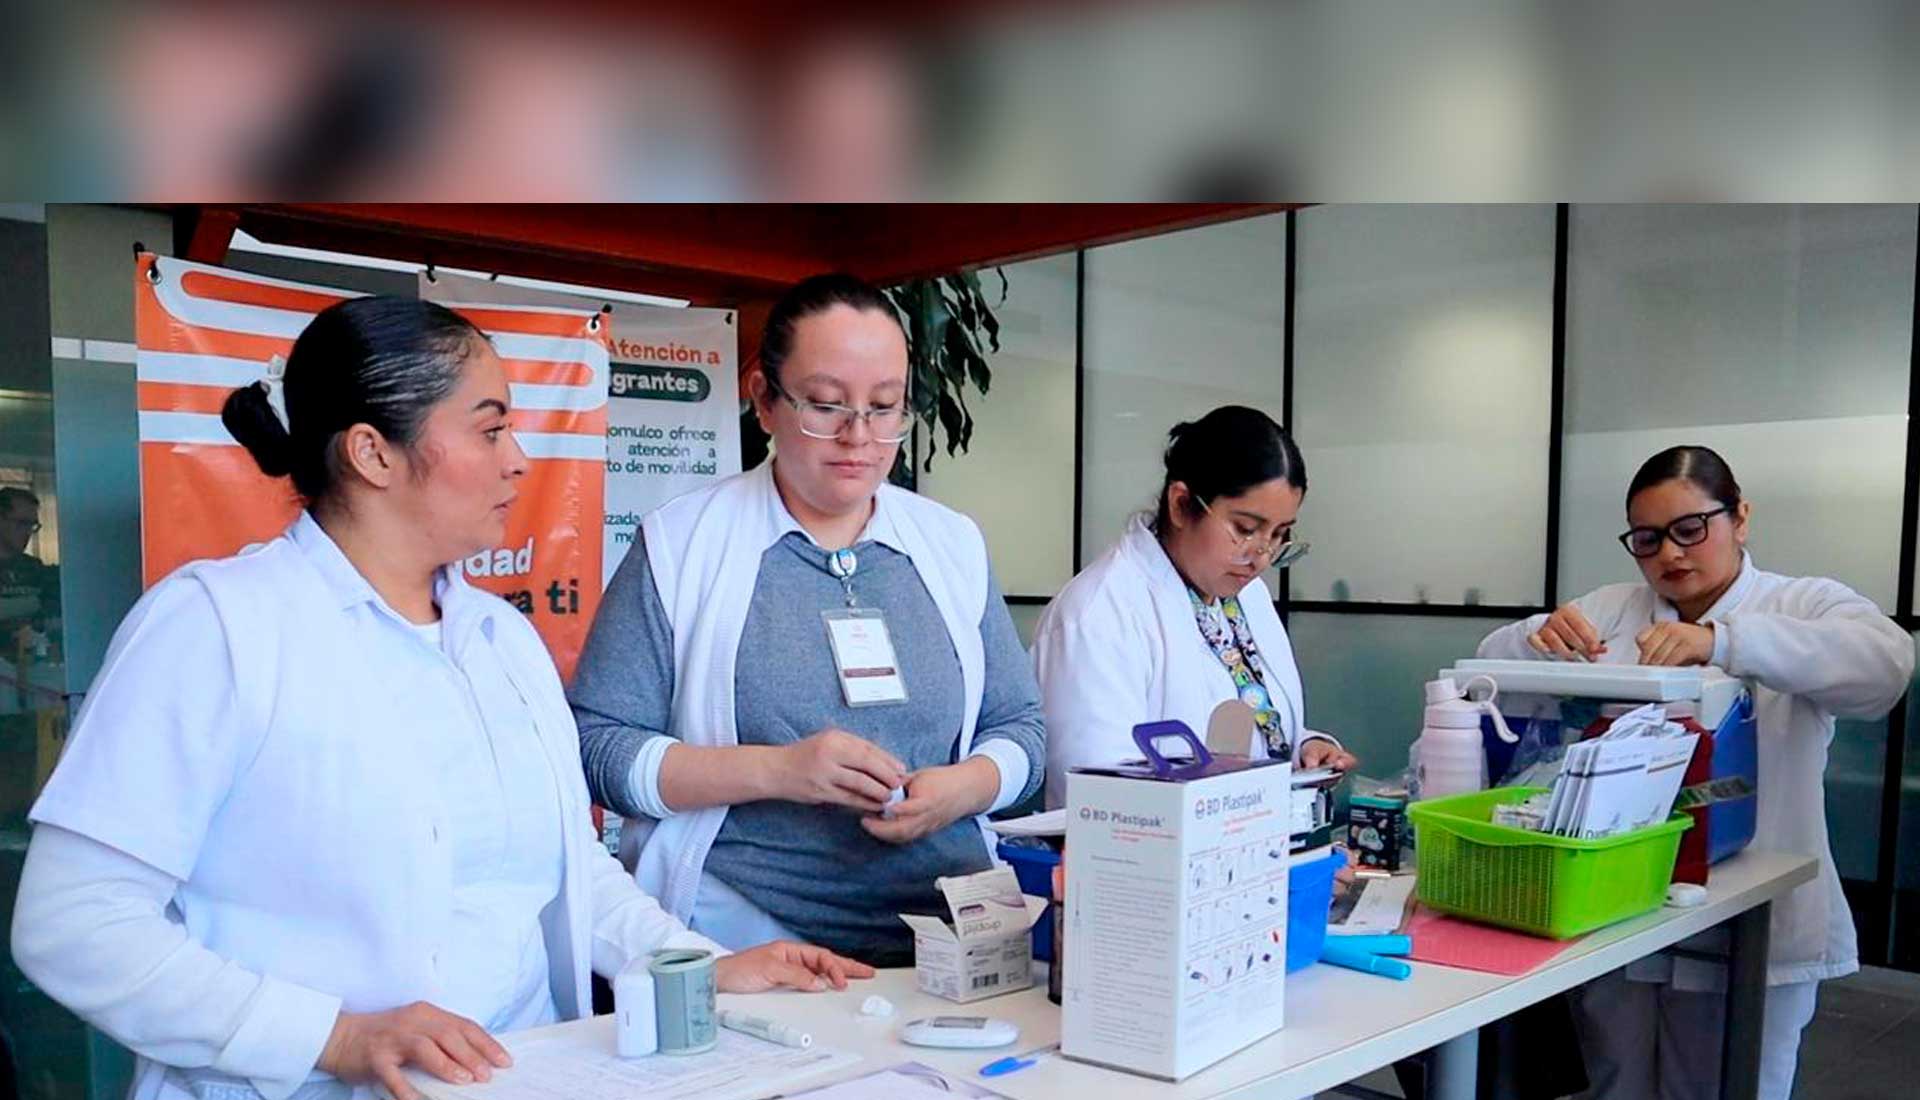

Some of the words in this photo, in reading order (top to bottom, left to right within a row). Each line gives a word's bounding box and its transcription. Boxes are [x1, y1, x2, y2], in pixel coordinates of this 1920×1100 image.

[608, 338, 702, 363] Atención
[707, 350, 721, 365] a
[669, 425, 716, 441] ofrece
[628, 442, 690, 457] atención
[708, 447, 716, 458] a
[626, 460, 643, 473] de
[648, 462, 716, 475] movilidad
[545, 578, 579, 615] ti
[1092, 809, 1109, 821] BD
[1111, 811, 1162, 829] Plastipak
